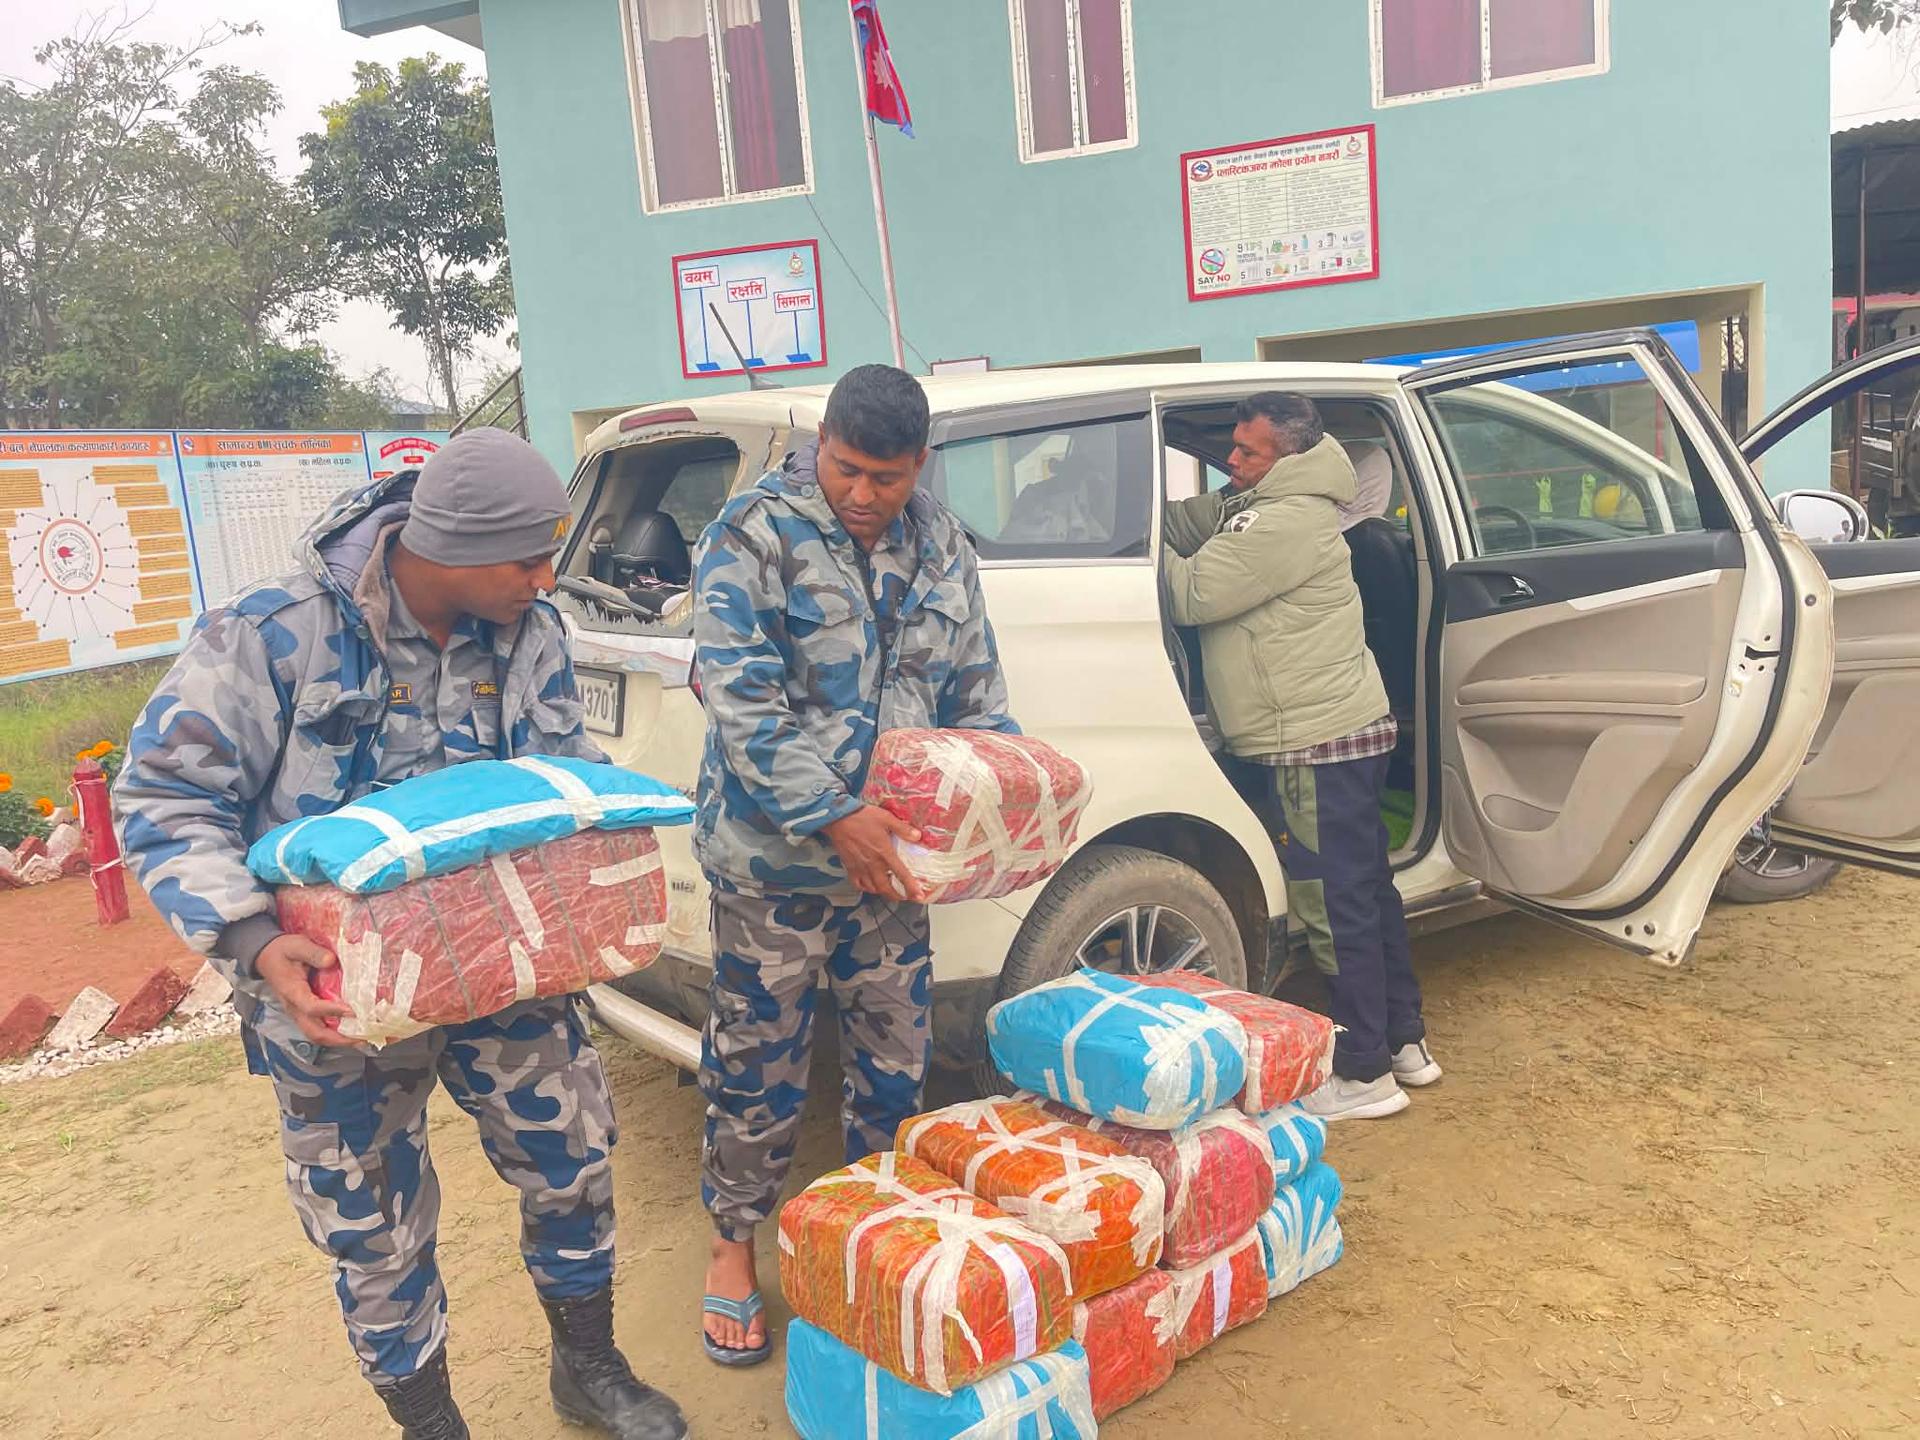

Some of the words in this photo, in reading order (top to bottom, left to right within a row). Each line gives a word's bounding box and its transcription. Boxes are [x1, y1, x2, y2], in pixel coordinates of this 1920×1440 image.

[1198, 276, 1215, 285] SAY
[1217, 273, 1231, 283] NO
[729, 281, 763, 300] रक्षति
